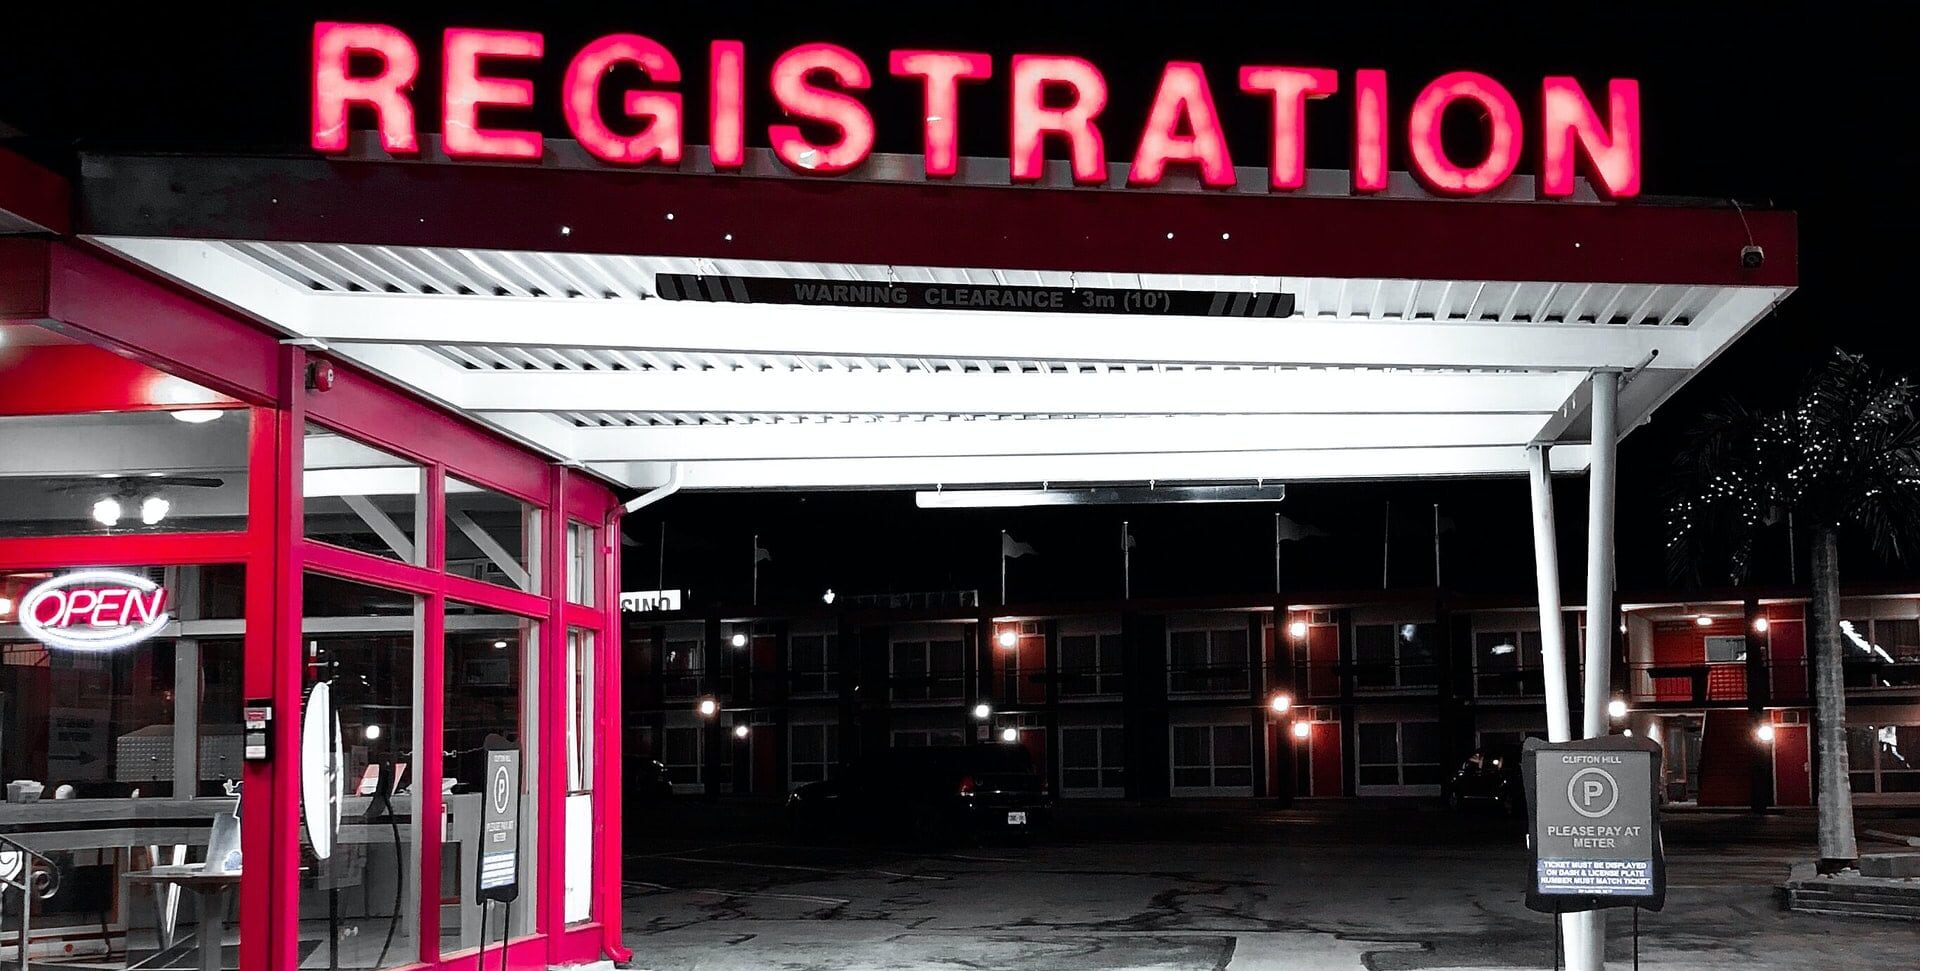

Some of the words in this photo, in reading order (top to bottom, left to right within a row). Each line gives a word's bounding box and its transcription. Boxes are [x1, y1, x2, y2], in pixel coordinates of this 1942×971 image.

[311, 21, 1640, 198] REGISTRATION
[793, 283, 908, 304] WARNING
[924, 287, 1064, 308] CLEARANCE
[1081, 290, 1115, 308] 3m
[1122, 291, 1171, 312] (10')
[30, 587, 166, 628] OPEN
[1562, 755, 1600, 764] CLIFTON
[1602, 756, 1622, 764] HILL
[1583, 781, 1604, 806] P
[1547, 826, 1595, 836] PLEASE
[1597, 826, 1622, 836] PAY
[1624, 826, 1640, 836] AT
[1573, 838, 1615, 848] METER
[1544, 861, 1570, 869] TICKET
[1571, 861, 1592, 869] MUST
[1540, 877, 1572, 885] NUMBER
[1573, 877, 1595, 885] MUST
[1623, 878, 1650, 886] TICKET
